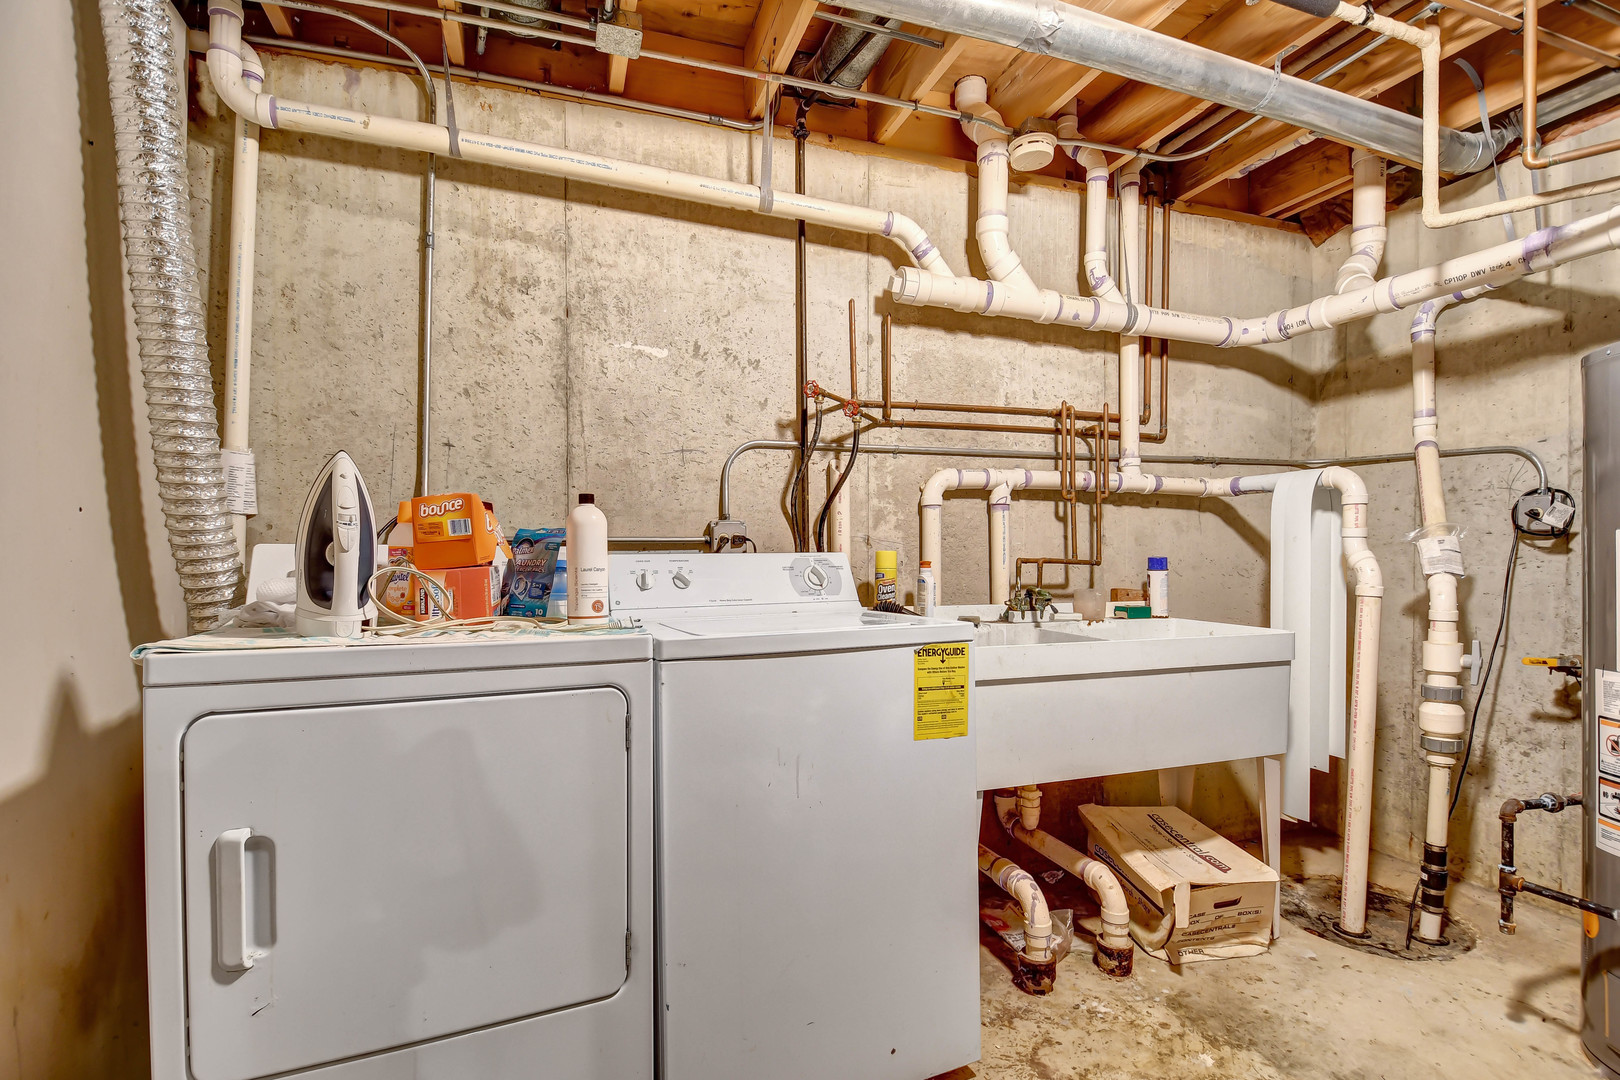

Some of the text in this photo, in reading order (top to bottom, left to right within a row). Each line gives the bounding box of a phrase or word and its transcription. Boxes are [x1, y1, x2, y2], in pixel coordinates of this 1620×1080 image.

[1471, 268, 1486, 278] DWV
[420, 498, 464, 518] bounce
[514, 559, 547, 567] AUNDRY
[878, 583, 896, 594] Oven
[535, 608, 543, 616] 10
[917, 647, 966, 658] ENERGYGUIDE
[1177, 949, 1205, 957] OTHER
